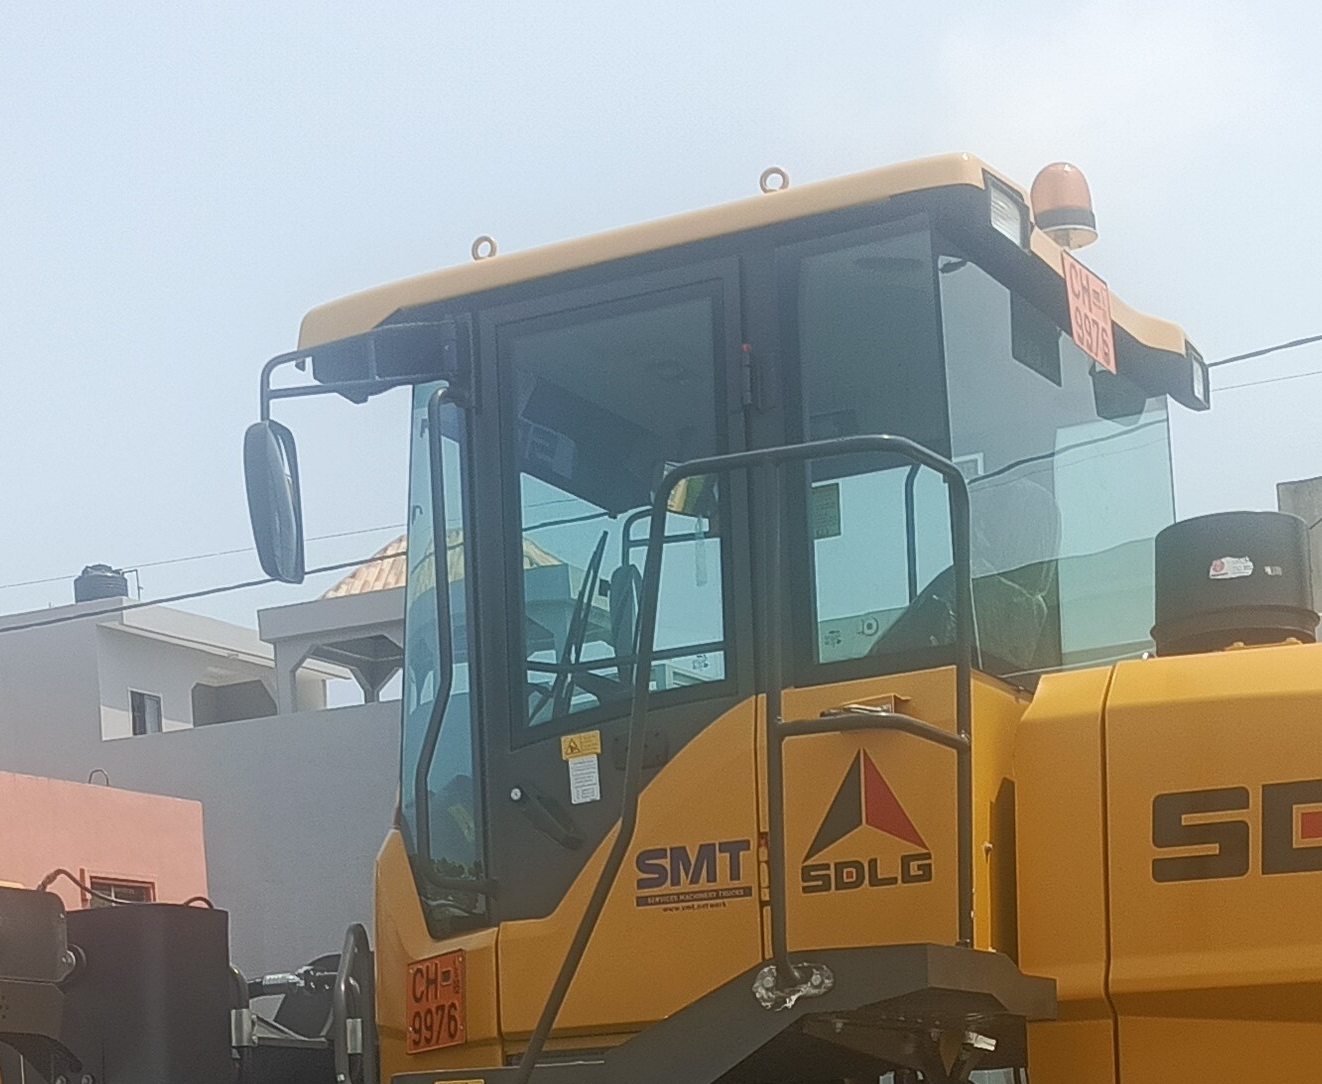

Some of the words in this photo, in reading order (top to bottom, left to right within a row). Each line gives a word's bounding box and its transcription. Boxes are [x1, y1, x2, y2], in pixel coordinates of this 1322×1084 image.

[636, 840, 751, 891] SMT
[801, 852, 933, 894] SDLG
[412, 1001, 458, 1048] 9976
